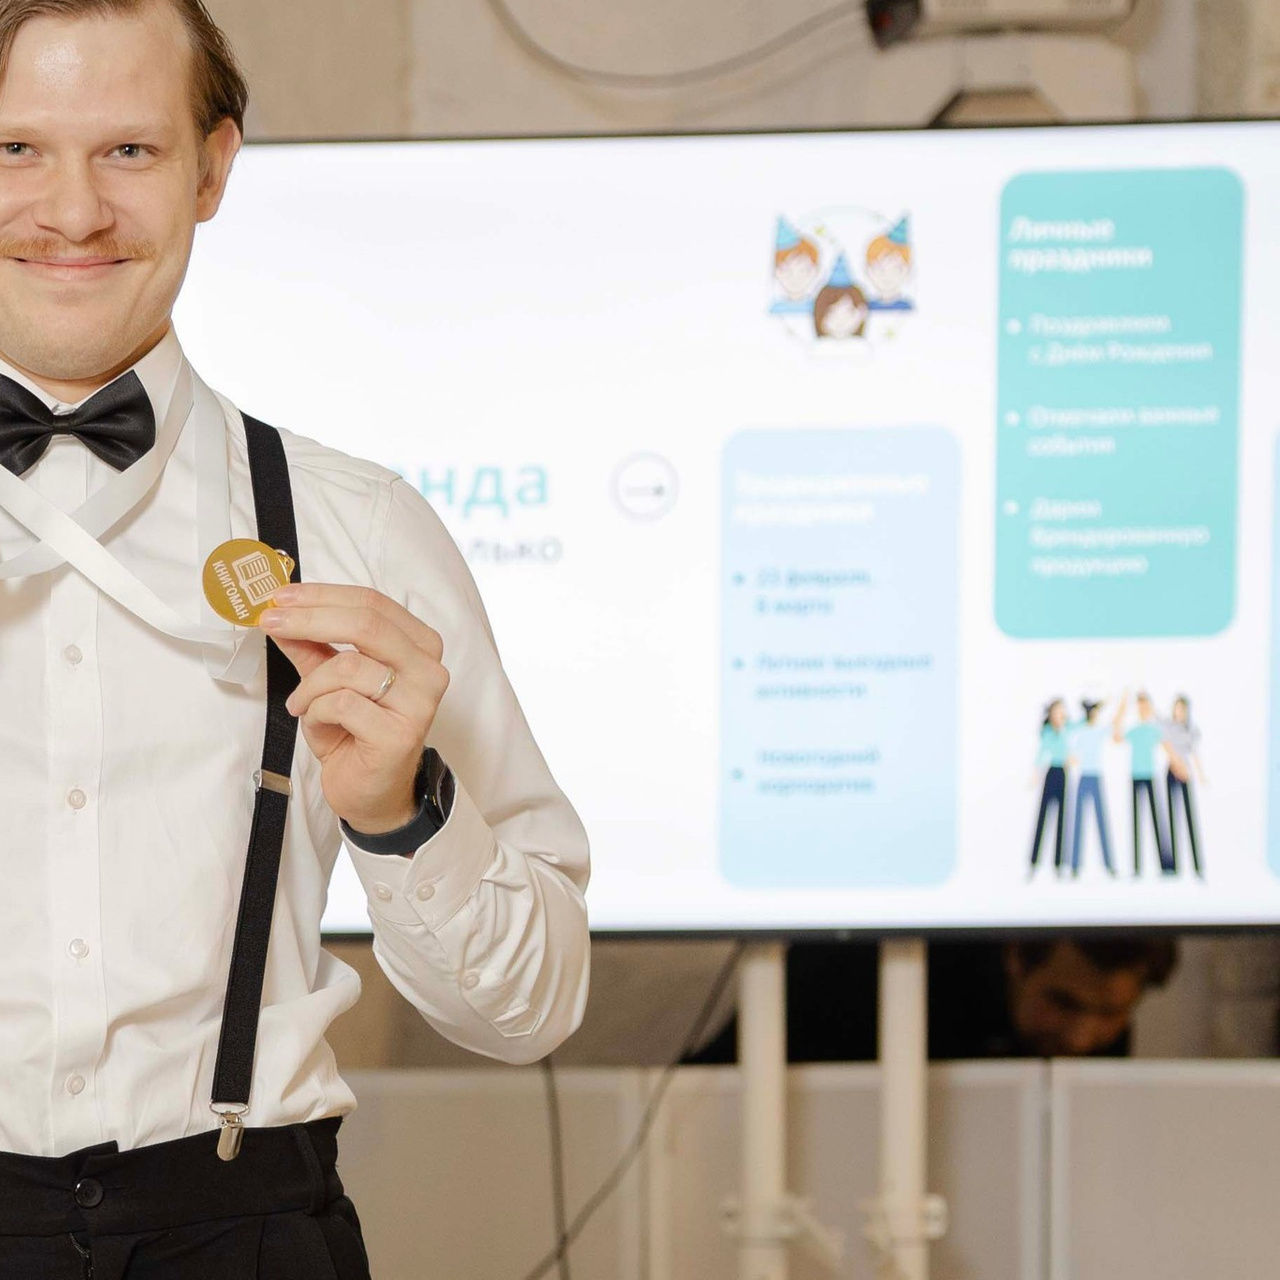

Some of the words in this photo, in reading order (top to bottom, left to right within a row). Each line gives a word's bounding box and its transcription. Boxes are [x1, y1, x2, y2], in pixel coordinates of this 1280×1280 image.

[1009, 216, 1114, 241] Личные
[1008, 247, 1153, 275] праздники
[212, 560, 250, 620] КНИГОМАН
